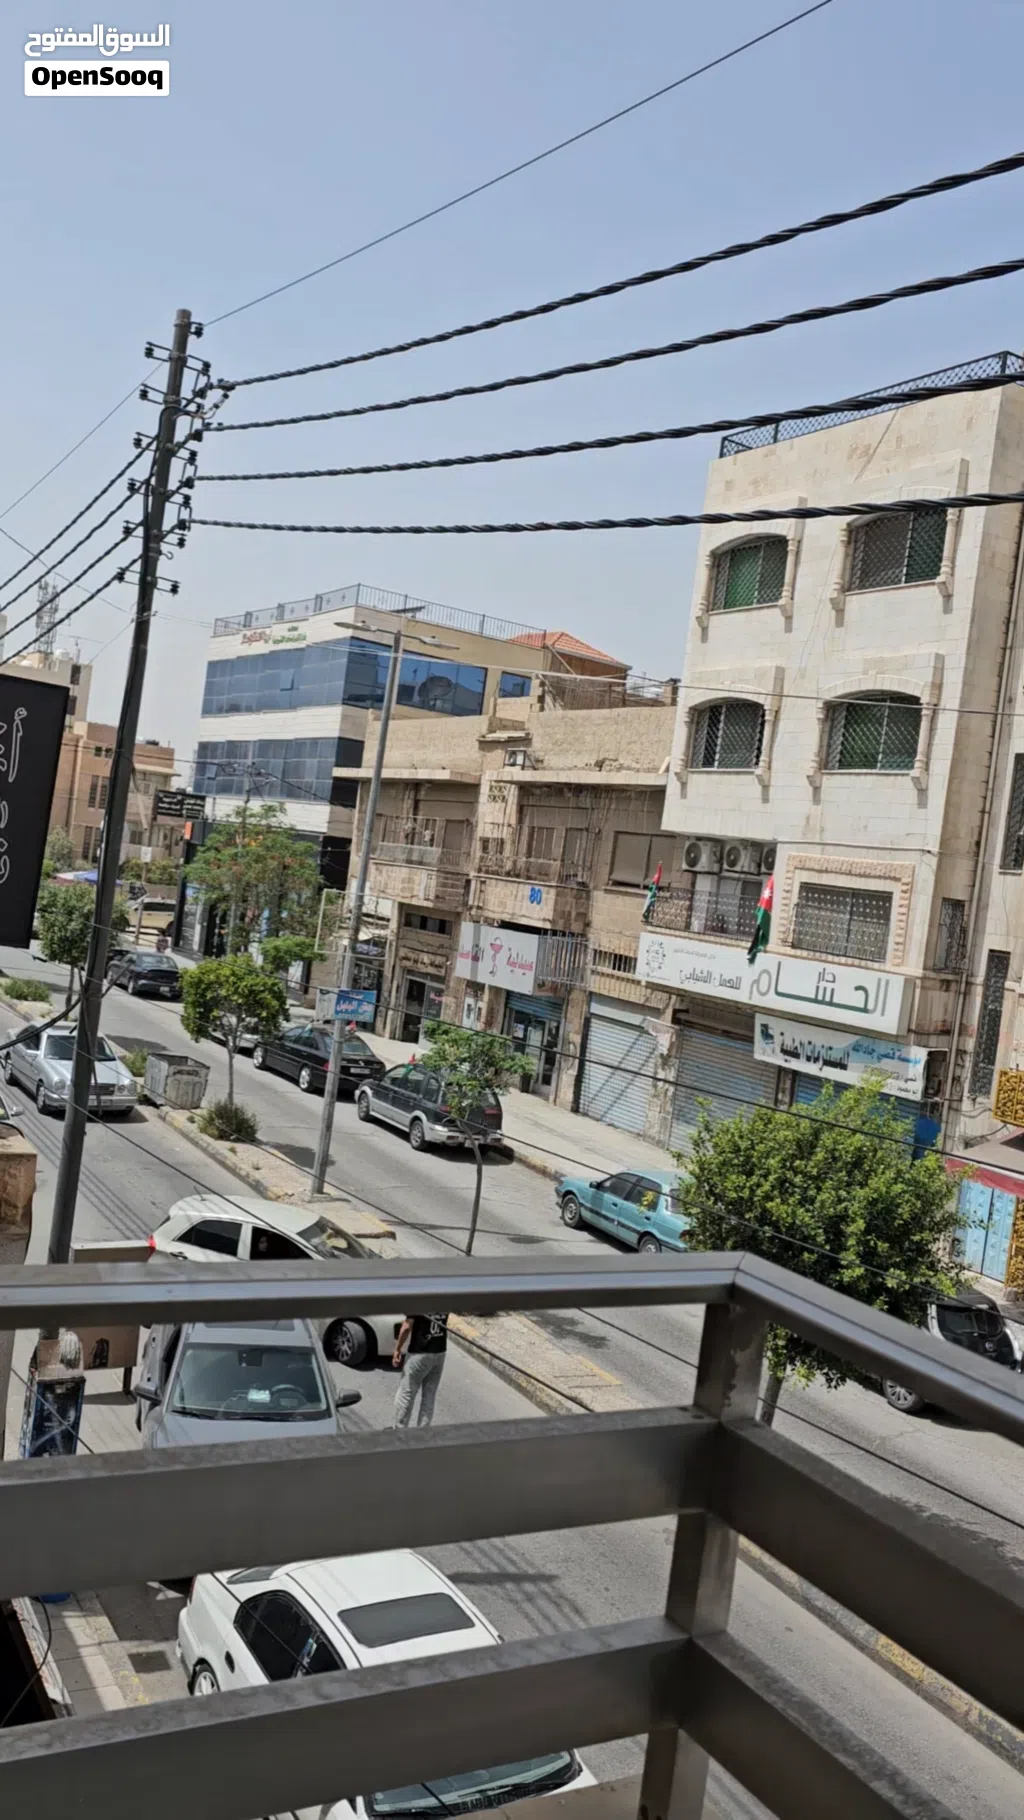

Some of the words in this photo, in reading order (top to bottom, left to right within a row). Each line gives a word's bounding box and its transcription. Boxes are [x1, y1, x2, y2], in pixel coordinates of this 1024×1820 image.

[679, 967, 712, 985] الشبابي
[712, 973, 742, 990] للعمل
[816, 967, 837, 985] دار
[749, 960, 890, 1017] الحسام
[779, 1031, 806, 1063] الطبية
